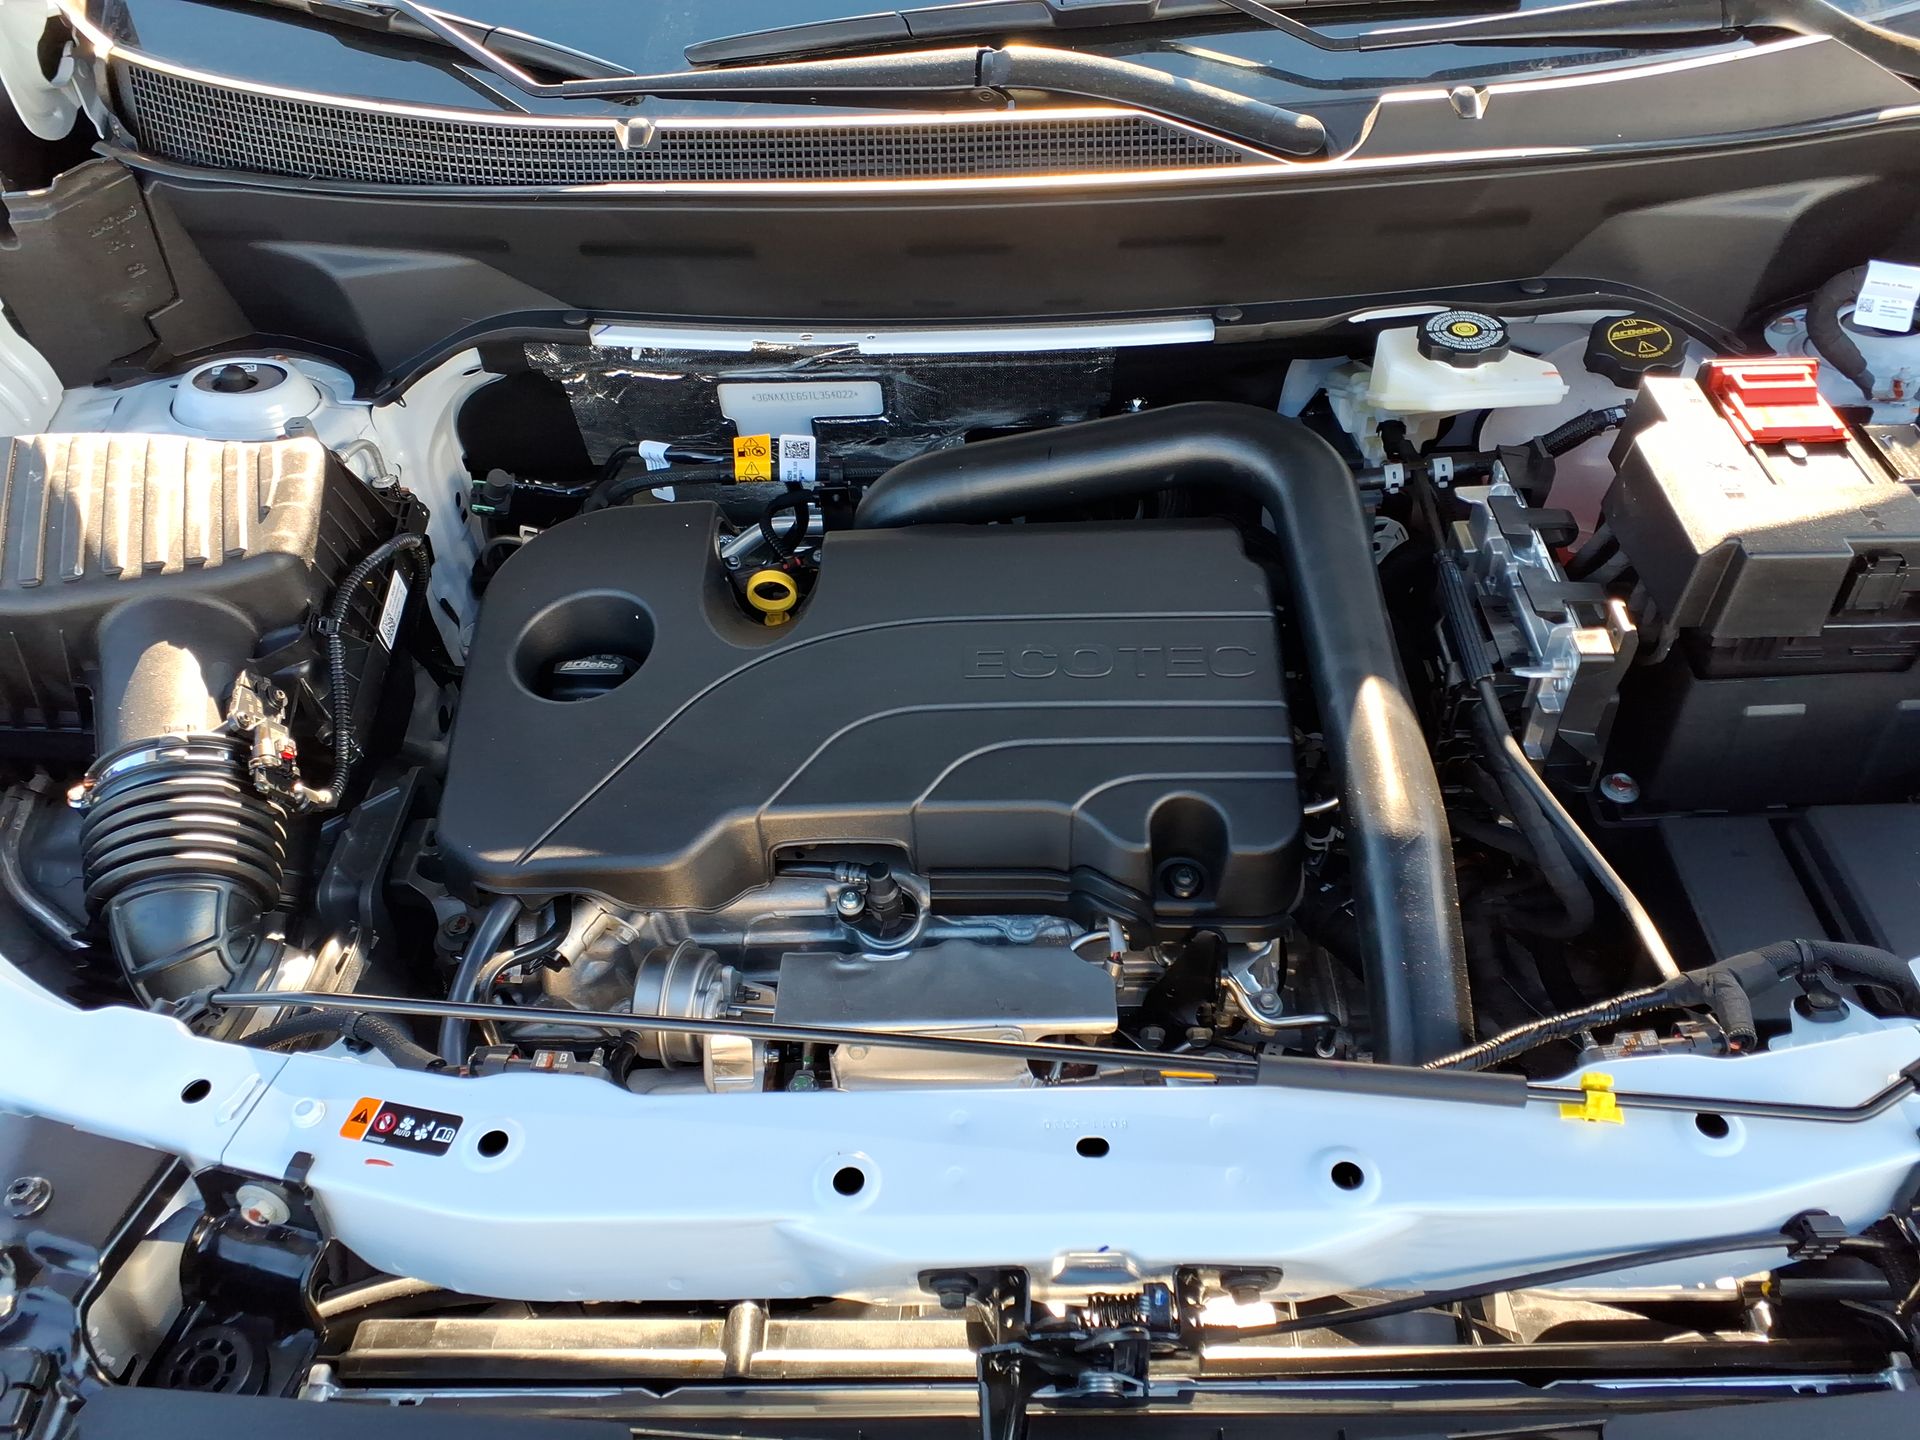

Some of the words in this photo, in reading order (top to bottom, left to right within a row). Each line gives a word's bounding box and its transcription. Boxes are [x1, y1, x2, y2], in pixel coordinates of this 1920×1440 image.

[1611, 326, 1662, 340] ACDelco
[560, 661, 618, 671] ACDelco
[963, 646, 1257, 678] ECOTEC
[393, 1128, 412, 1138] AUTO
